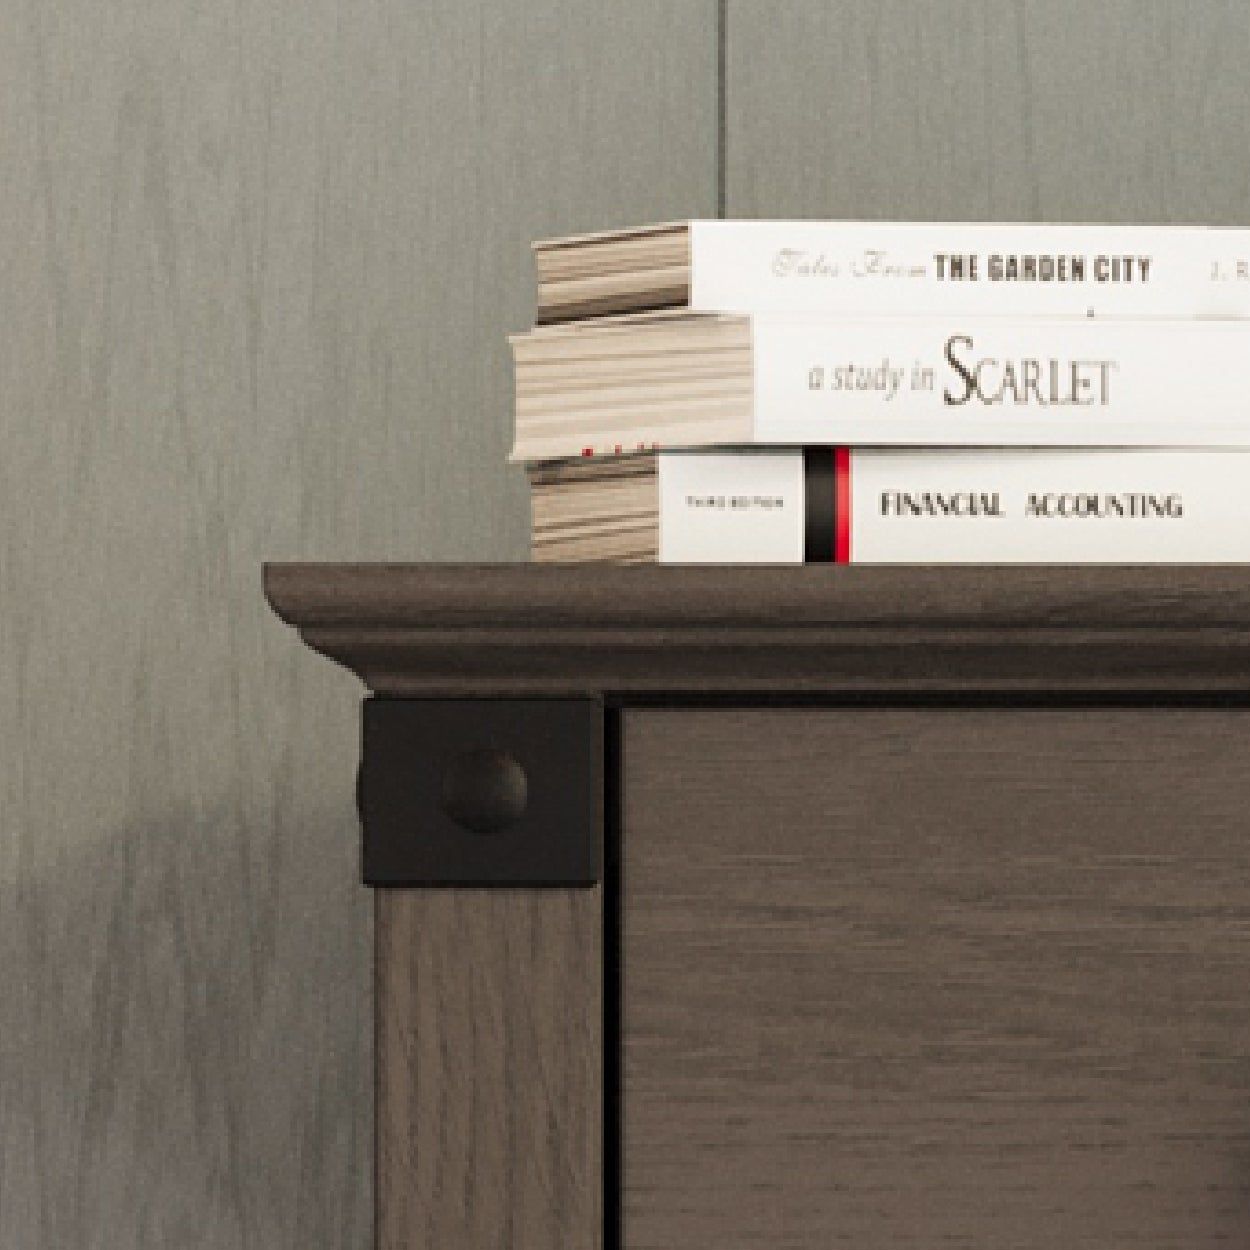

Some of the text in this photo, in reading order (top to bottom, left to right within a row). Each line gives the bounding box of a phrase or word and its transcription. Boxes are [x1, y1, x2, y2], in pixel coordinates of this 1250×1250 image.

[772, 248, 1153, 284] Tales From THE GARDEN CITY
[808, 364, 825, 391] a
[831, 358, 905, 401] study
[910, 359, 935, 391] in
[880, 489, 1184, 519] FINANCIAL ACCOUNTING
